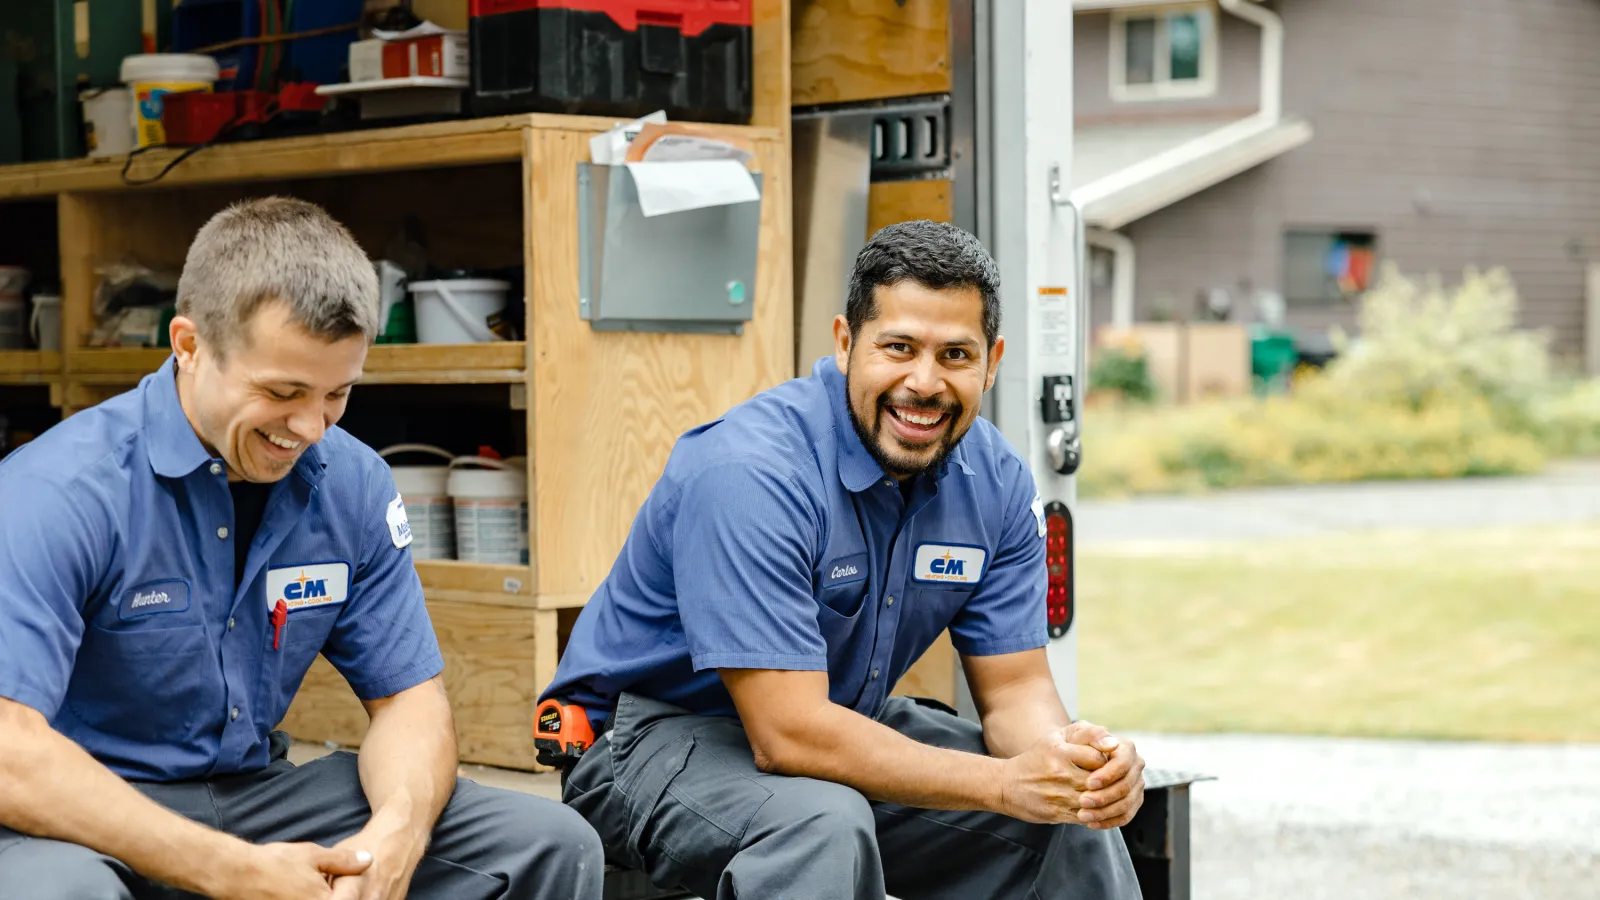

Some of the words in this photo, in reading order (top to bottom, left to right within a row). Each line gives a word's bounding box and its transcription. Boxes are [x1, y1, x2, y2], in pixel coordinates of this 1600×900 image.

[831, 564, 858, 579] Carlos
[930, 558, 963, 575] CM
[284, 579, 326, 600] CM
[131, 590, 171, 608] Hunter
